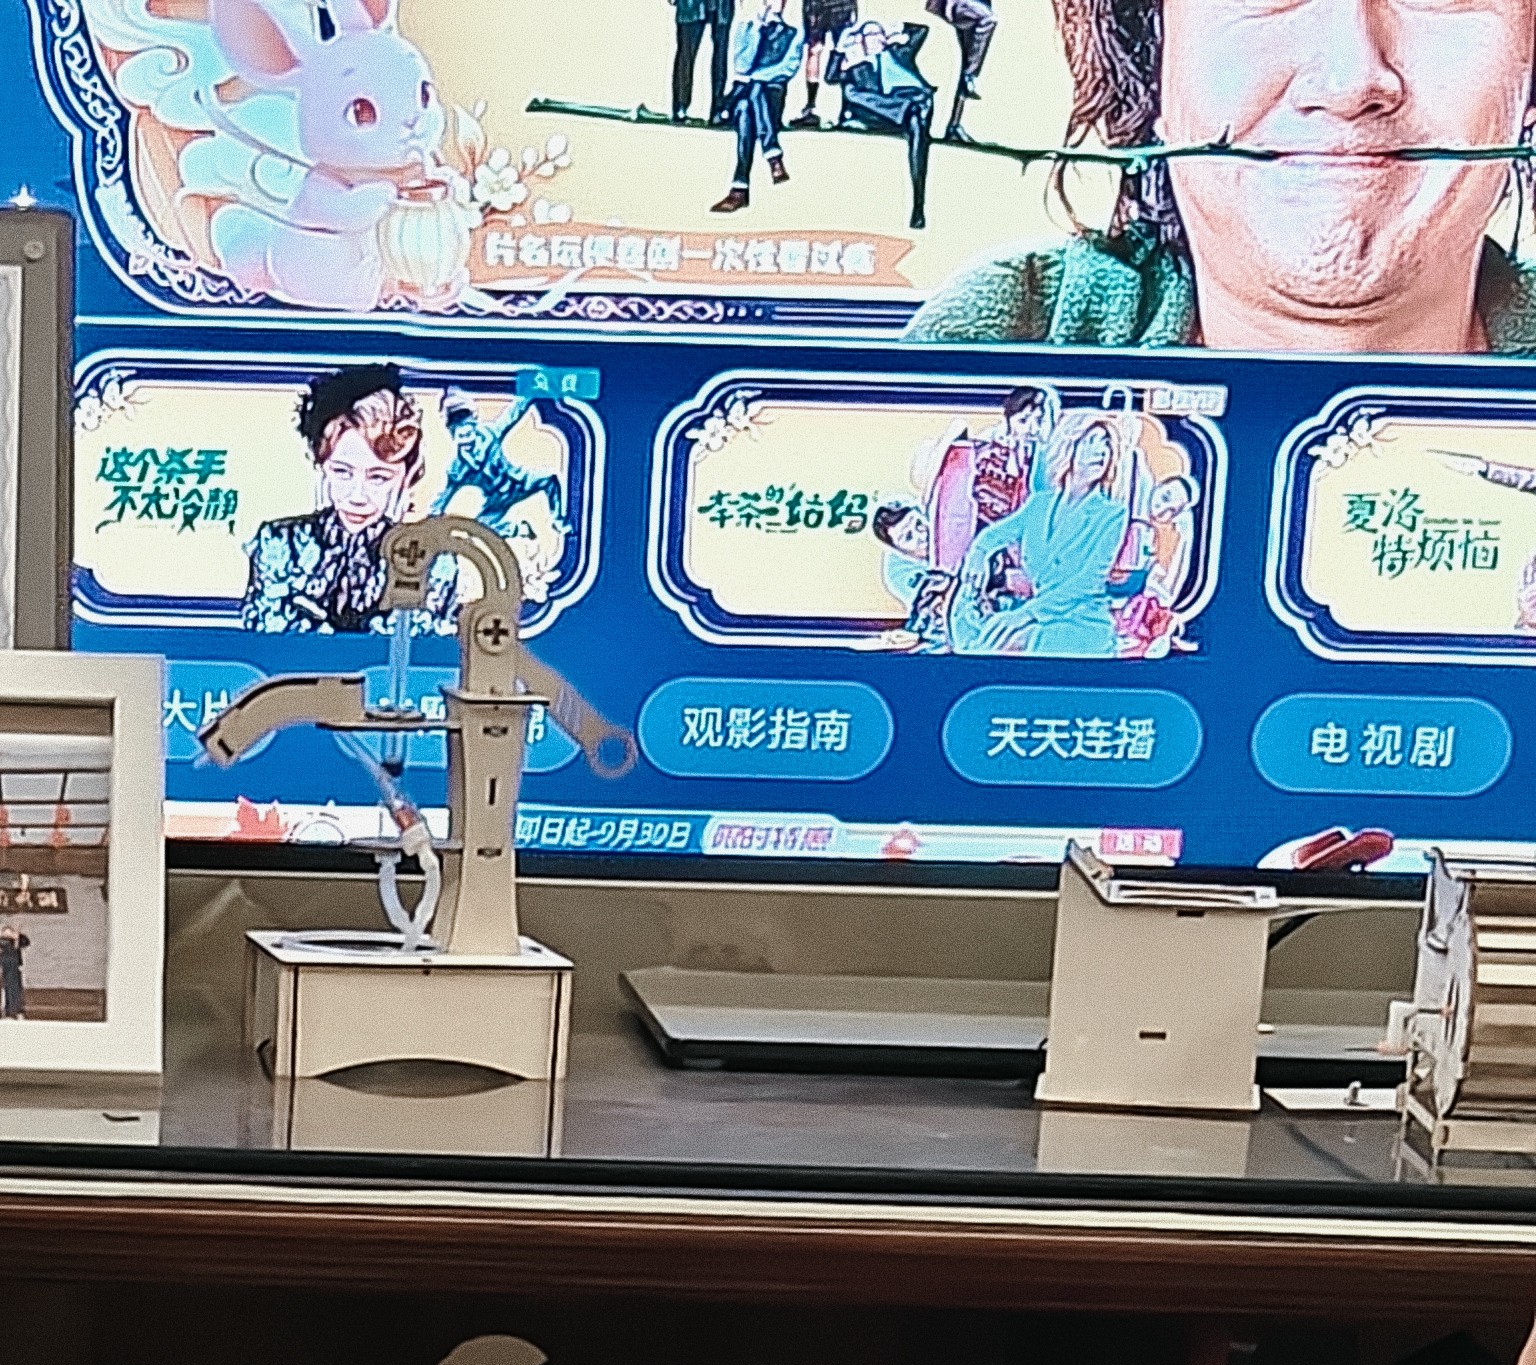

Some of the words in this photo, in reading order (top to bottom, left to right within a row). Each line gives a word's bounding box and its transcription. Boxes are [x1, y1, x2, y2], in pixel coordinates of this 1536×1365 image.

[95, 446, 229, 486] 这个杀手
[94, 486, 239, 536] 不太冷静
[697, 482, 869, 535] 李茶的姑妈
[1342, 486, 1426, 535] 夏洛
[1371, 528, 1503, 581] 特烦恼
[682, 706, 852, 754] 观影指南
[987, 715, 1158, 763] 天天连播
[1310, 724, 1457, 769] 电视剧
